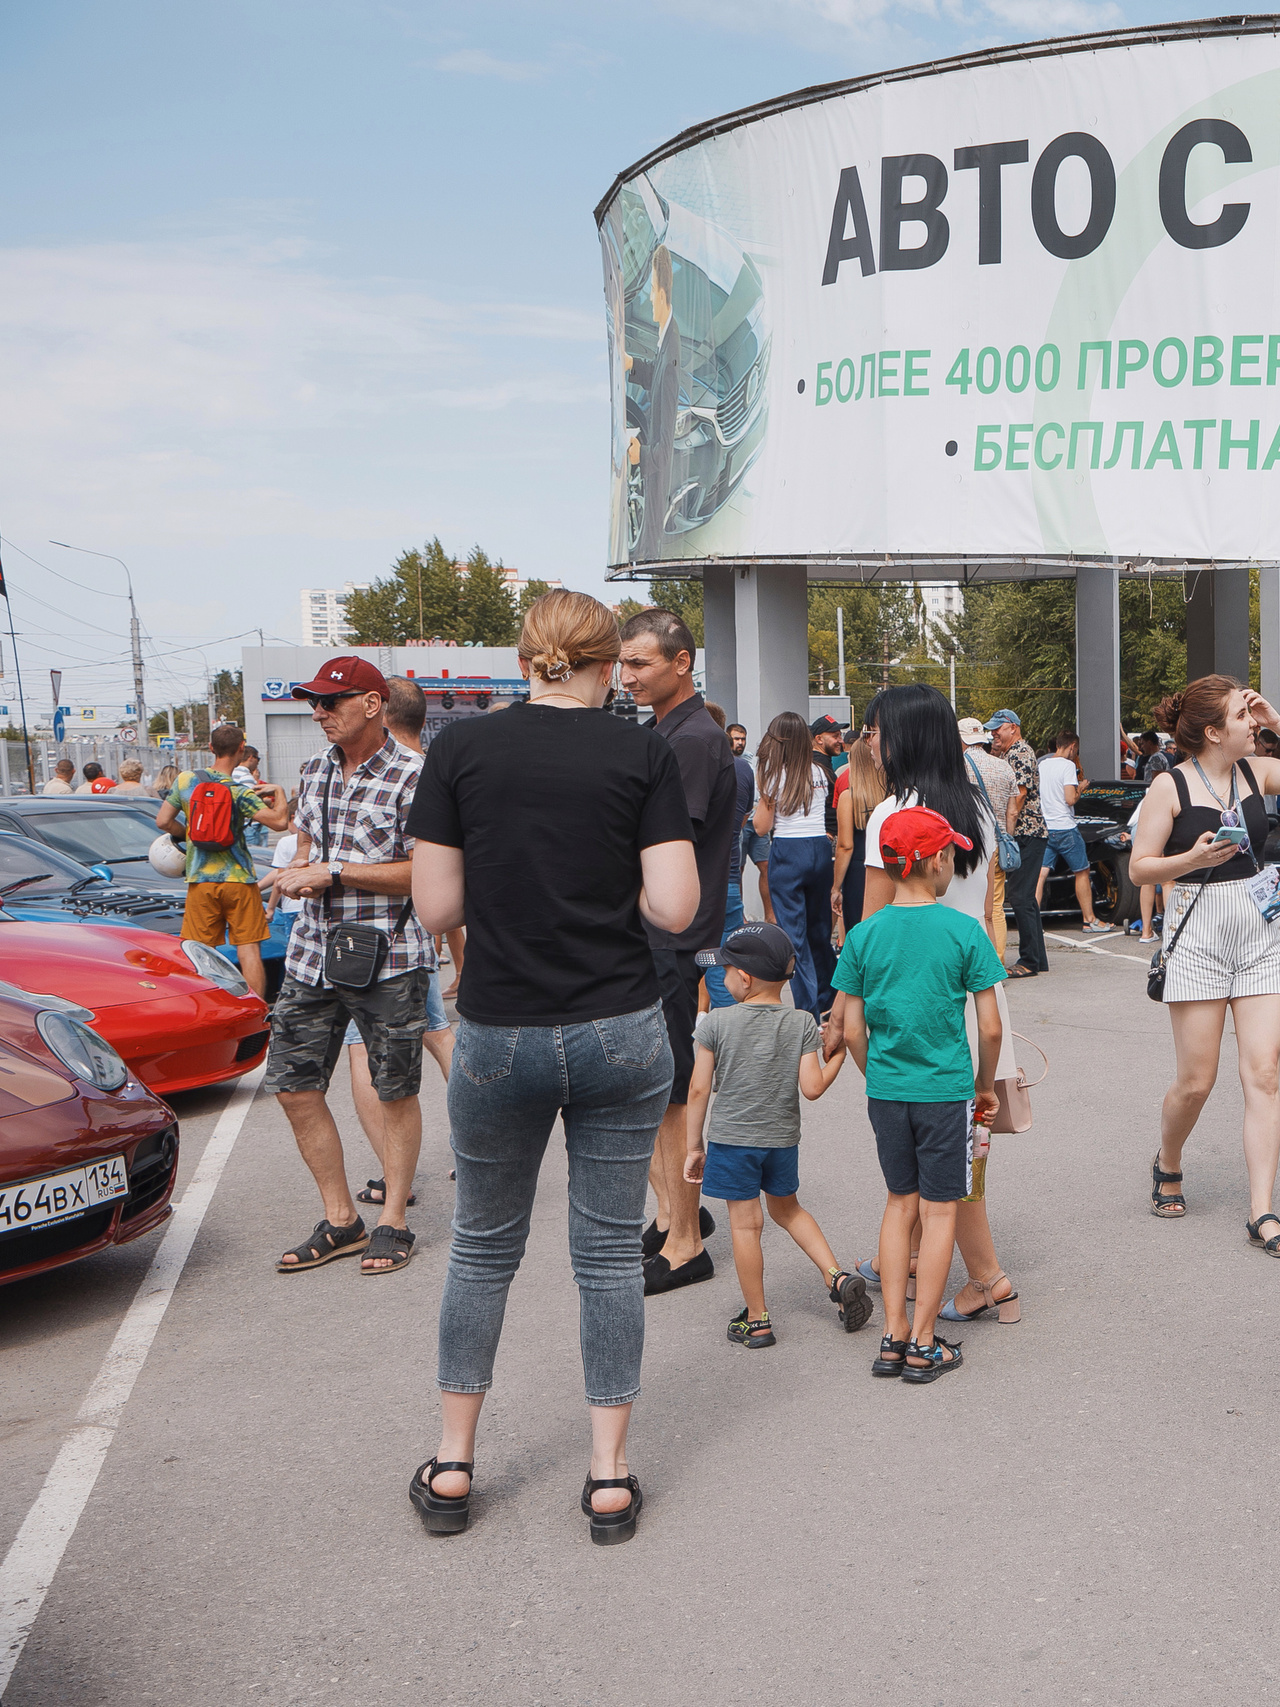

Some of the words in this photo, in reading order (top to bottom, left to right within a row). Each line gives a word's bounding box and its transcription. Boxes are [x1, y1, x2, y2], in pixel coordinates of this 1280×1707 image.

[822, 132, 1116, 285] АВТО
[1159, 119, 1252, 249] С
[816, 348, 931, 406] БОЛЕЕ
[945, 342, 1061, 397] 4000
[88, 1160, 122, 1191] 134
[98, 1185, 115, 1199] RUS
[31, 1221, 48, 1231] Porsche
